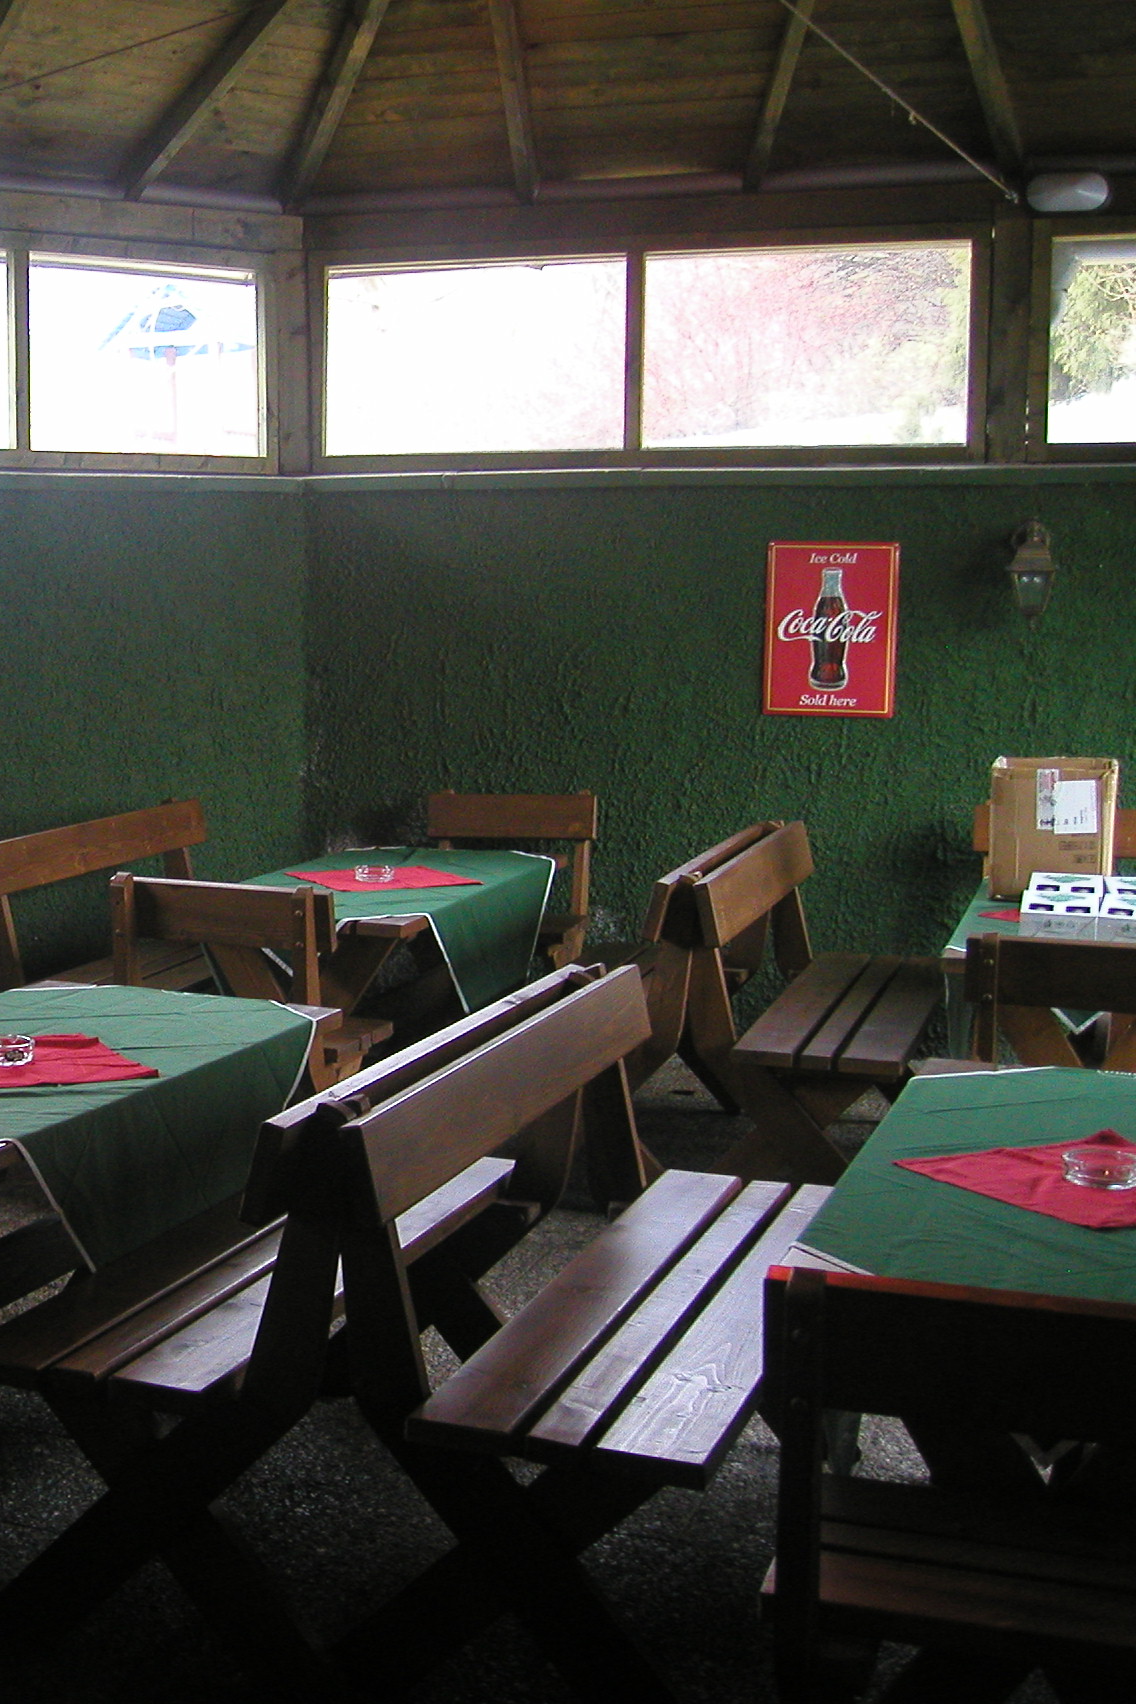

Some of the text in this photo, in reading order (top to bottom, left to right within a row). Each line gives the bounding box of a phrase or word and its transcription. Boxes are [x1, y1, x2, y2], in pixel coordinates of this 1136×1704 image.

[809, 553, 858, 563] Ice Cold
[777, 608, 883, 643] Coca-Cola
[799, 694, 857, 707] Sold here
